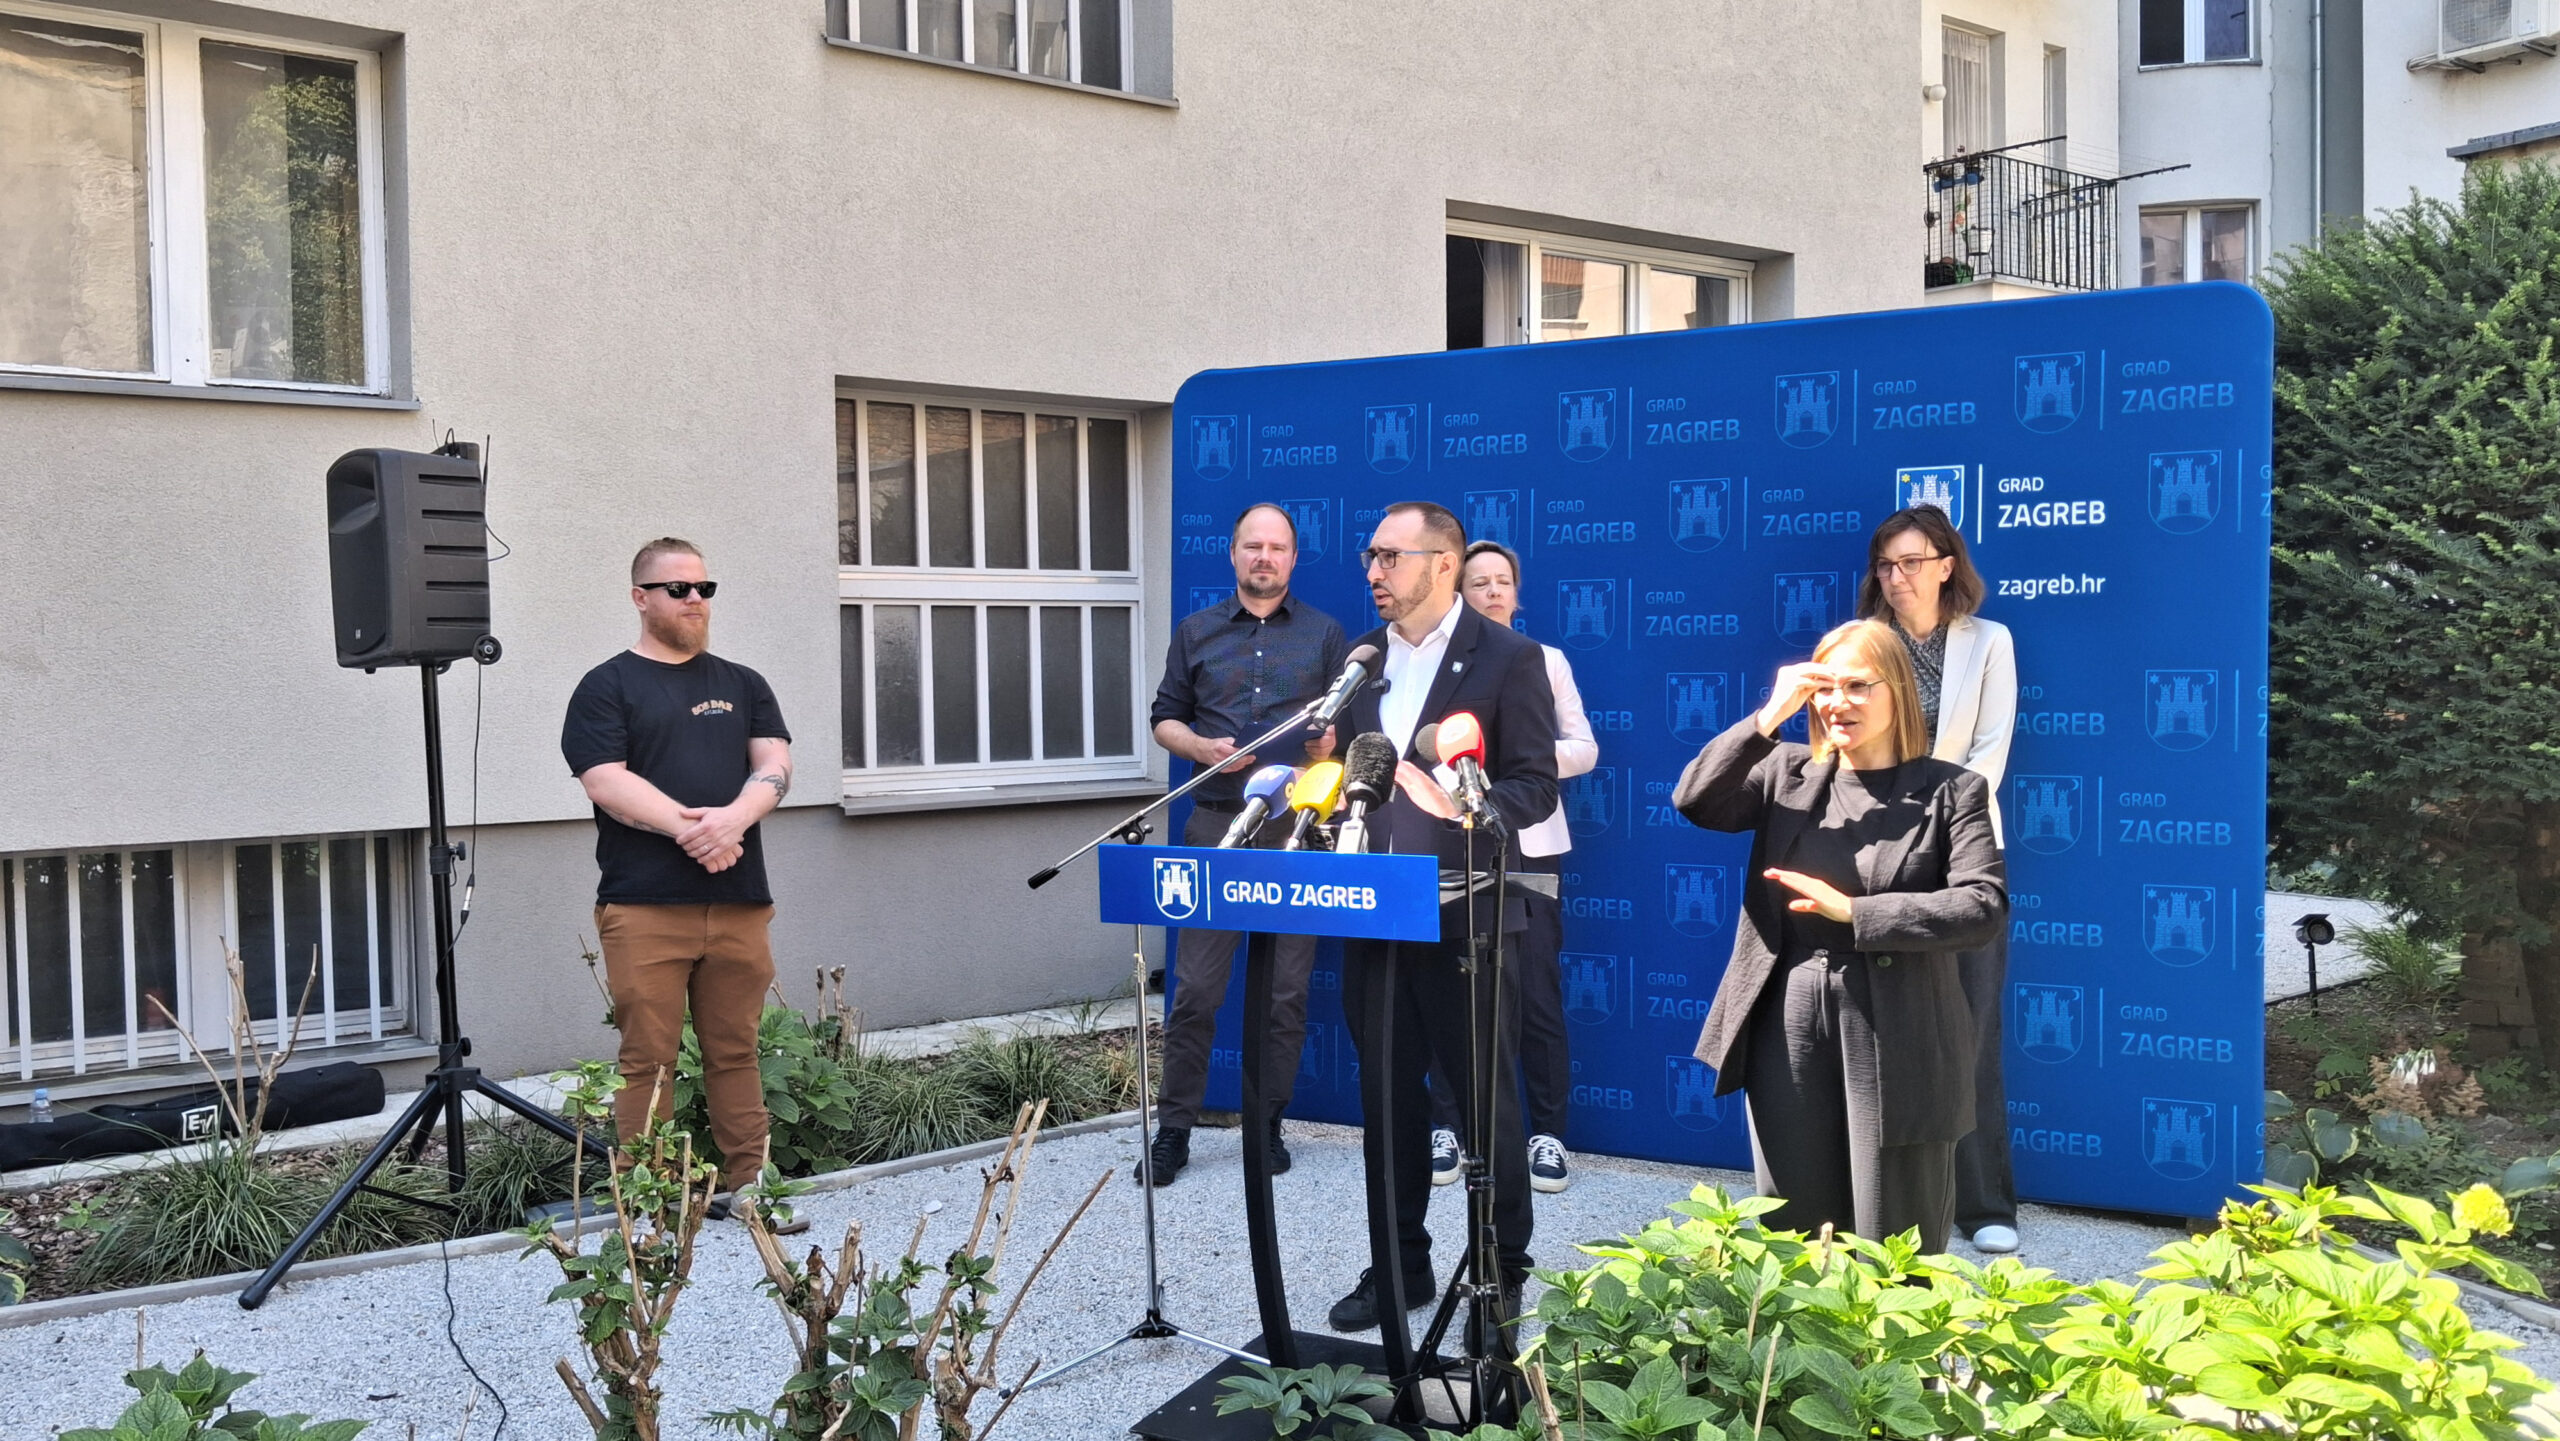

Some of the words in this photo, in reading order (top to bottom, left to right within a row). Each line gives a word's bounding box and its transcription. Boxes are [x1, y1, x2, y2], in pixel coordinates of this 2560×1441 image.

[2122, 360, 2170, 377] GRAD
[1873, 380, 1917, 396] GRAD
[2122, 383, 2234, 413] ZAGREB
[1646, 398, 1686, 413] GRAD
[1443, 413, 1479, 427] GRAD
[1873, 402, 1976, 430] ZAGREB
[1262, 425, 1294, 438] GRAD
[1646, 419, 1740, 445] ZAGREB
[1443, 434, 1527, 458] ZAGREB
[1262, 446, 1337, 467] ZAGREB
[1998, 477, 2044, 493] GRAD
[1762, 489, 1804, 503] GRAD
[1547, 500, 1584, 514] GRAD
[1998, 500, 2106, 528] ZAGREB
[1181, 514, 1212, 526] GRAD
[1762, 511, 1861, 536] ZAGREB
[1547, 522, 1636, 545] ZAGREB
[1181, 536, 1230, 555] ZAGR
[1998, 574, 2106, 600] zagreb.hr
[1646, 591, 1685, 604] GRAD
[1646, 614, 1739, 636] ZAGREB
[2020, 686, 2043, 700] AD
[1590, 711, 1634, 731] REB
[2014, 712, 2105, 735] AGREB
[1645, 782, 1678, 795] GRA
[2119, 793, 2166, 807] GRAD
[2119, 819, 2231, 845] ZAGREB
[1223, 881, 1282, 905] GRAD
[1290, 884, 1377, 910] ZAGREB
[2009, 894, 2041, 909] RAD
[1560, 896, 1632, 919] AGREB
[2012, 920, 2103, 947] AGREB
[1647, 972, 1687, 987] GRAD
[1647, 996, 1709, 1020] ZAGR
[2120, 1005, 2167, 1021] GRAD
[2120, 1032, 2234, 1063] ZAGREB
[1570, 1085, 1634, 1110] GREB
[2007, 1101, 2040, 1116] RAD
[2011, 1127, 2102, 1157] AGREB
